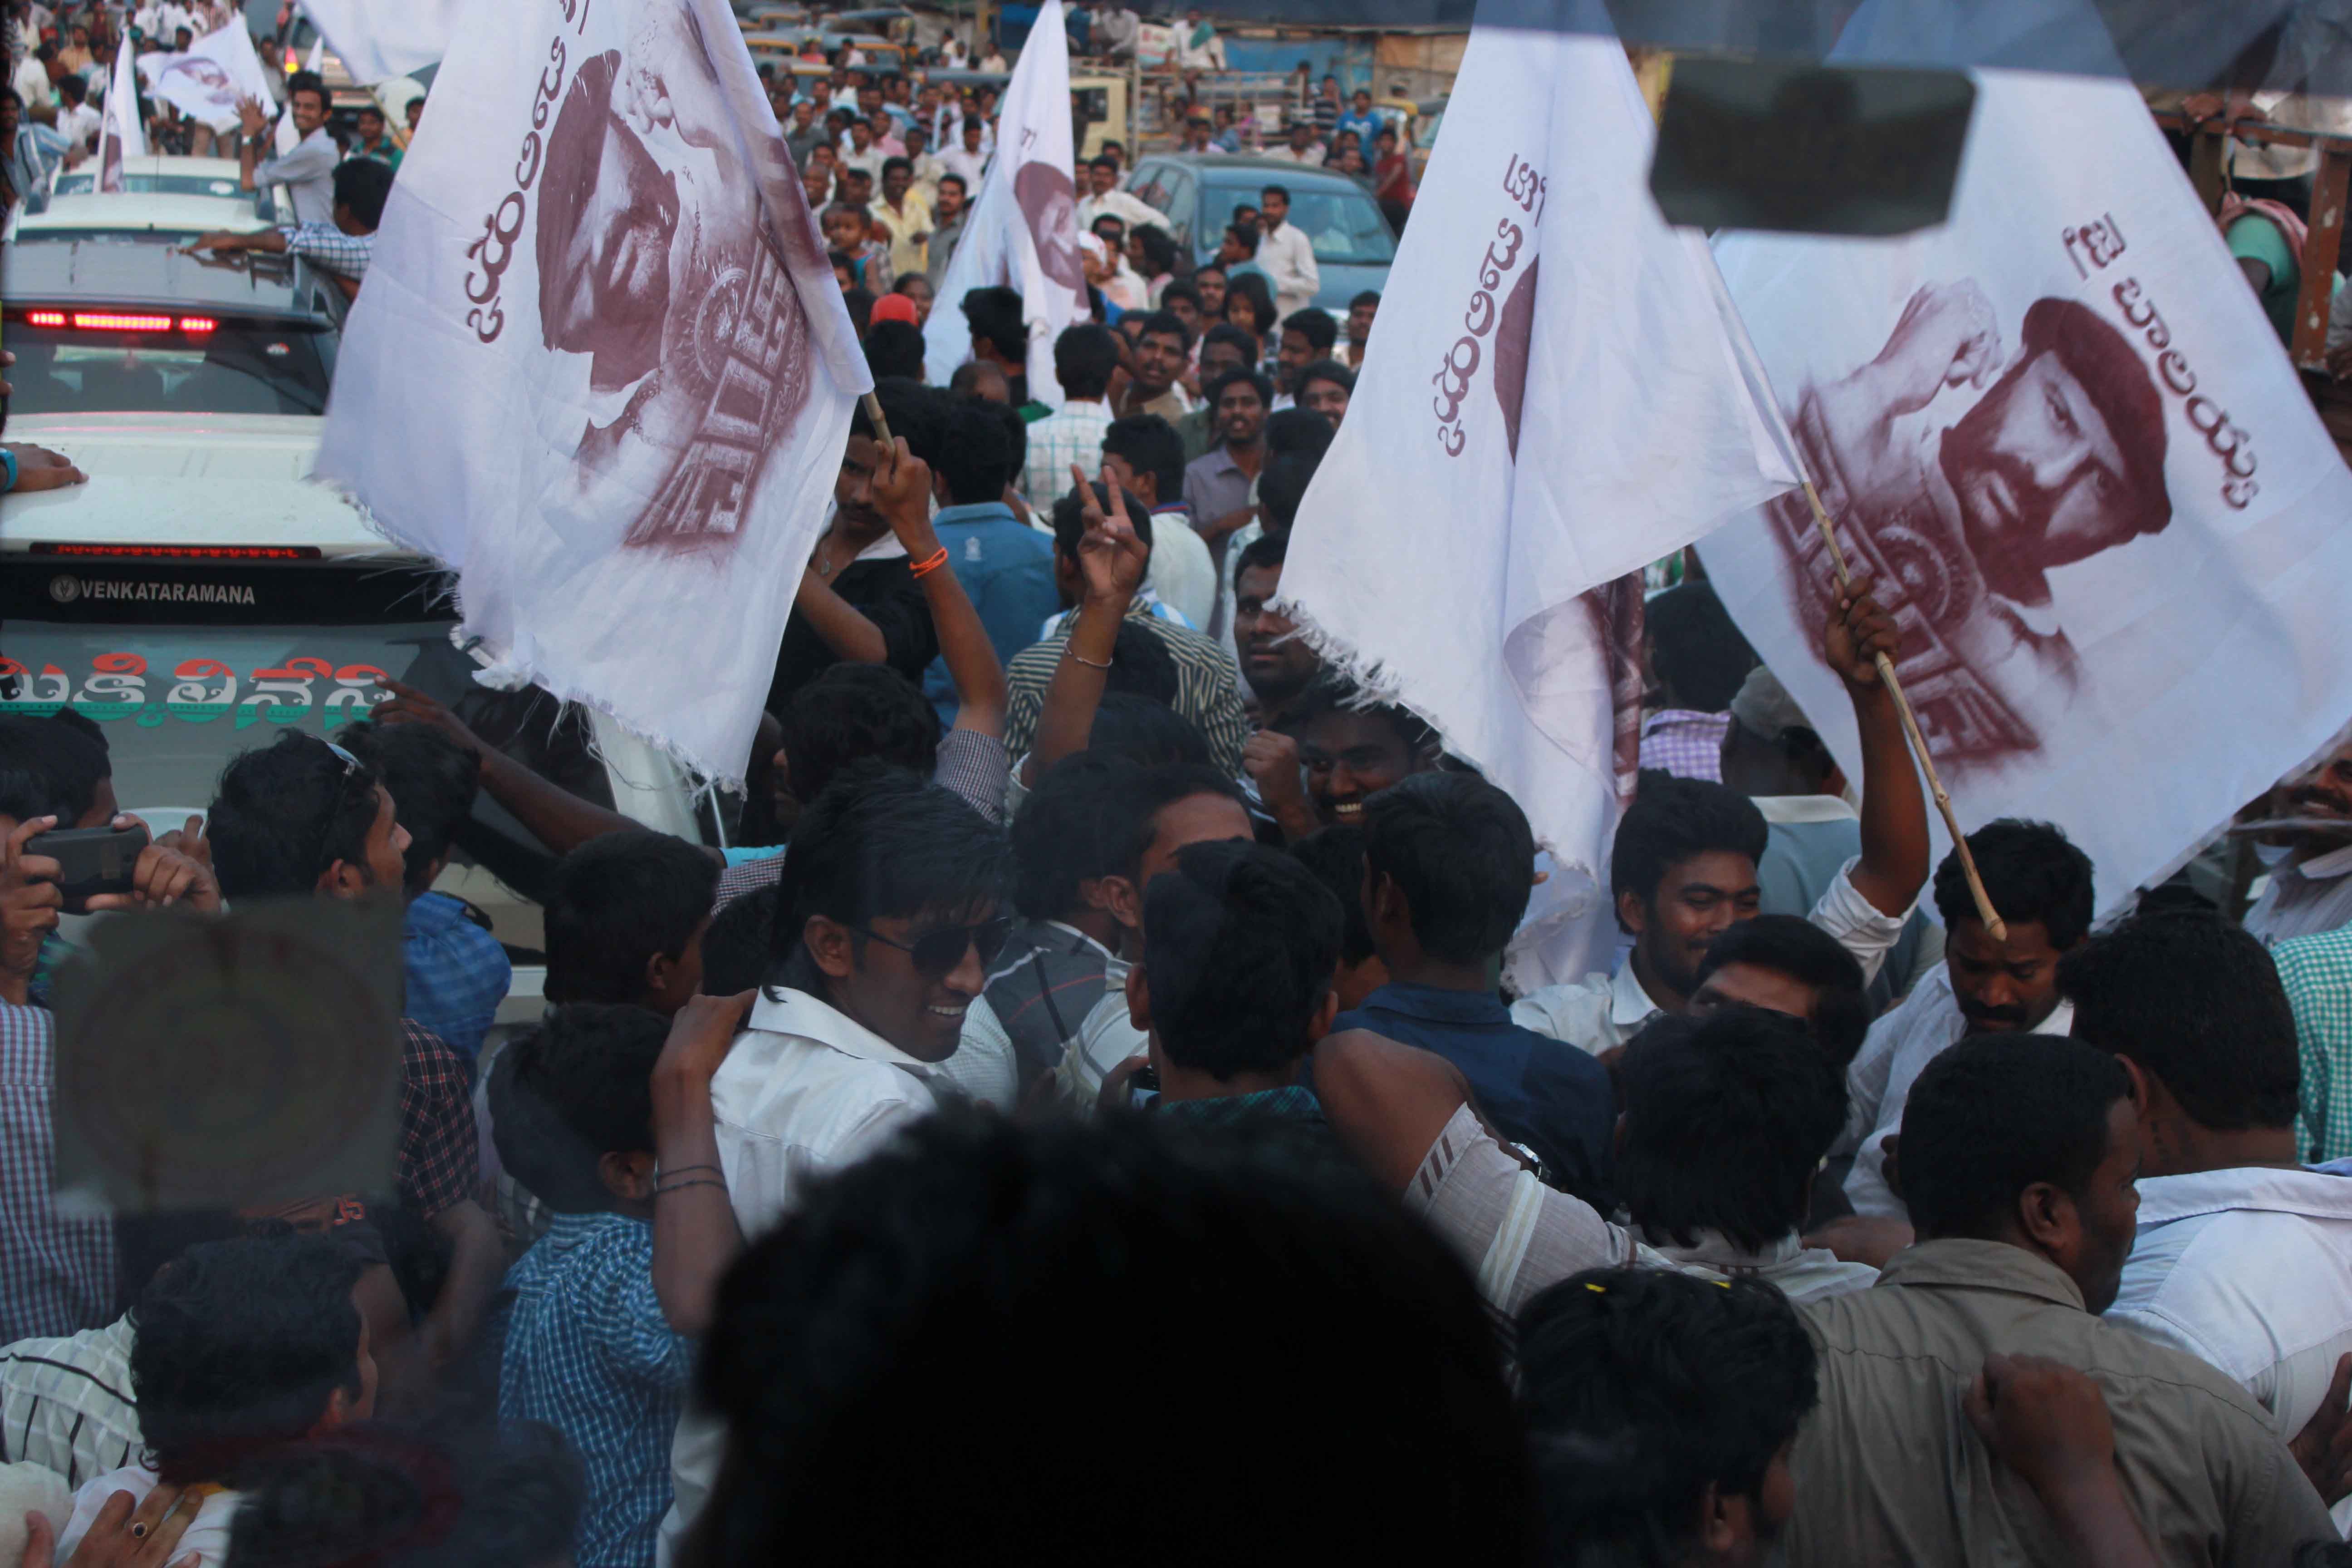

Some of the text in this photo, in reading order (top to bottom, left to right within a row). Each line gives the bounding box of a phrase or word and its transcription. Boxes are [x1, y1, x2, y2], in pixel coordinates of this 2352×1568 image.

[2062, 212, 2260, 510] జై బాలయ్య
[80, 579, 256, 604] VENKATARAMANA
